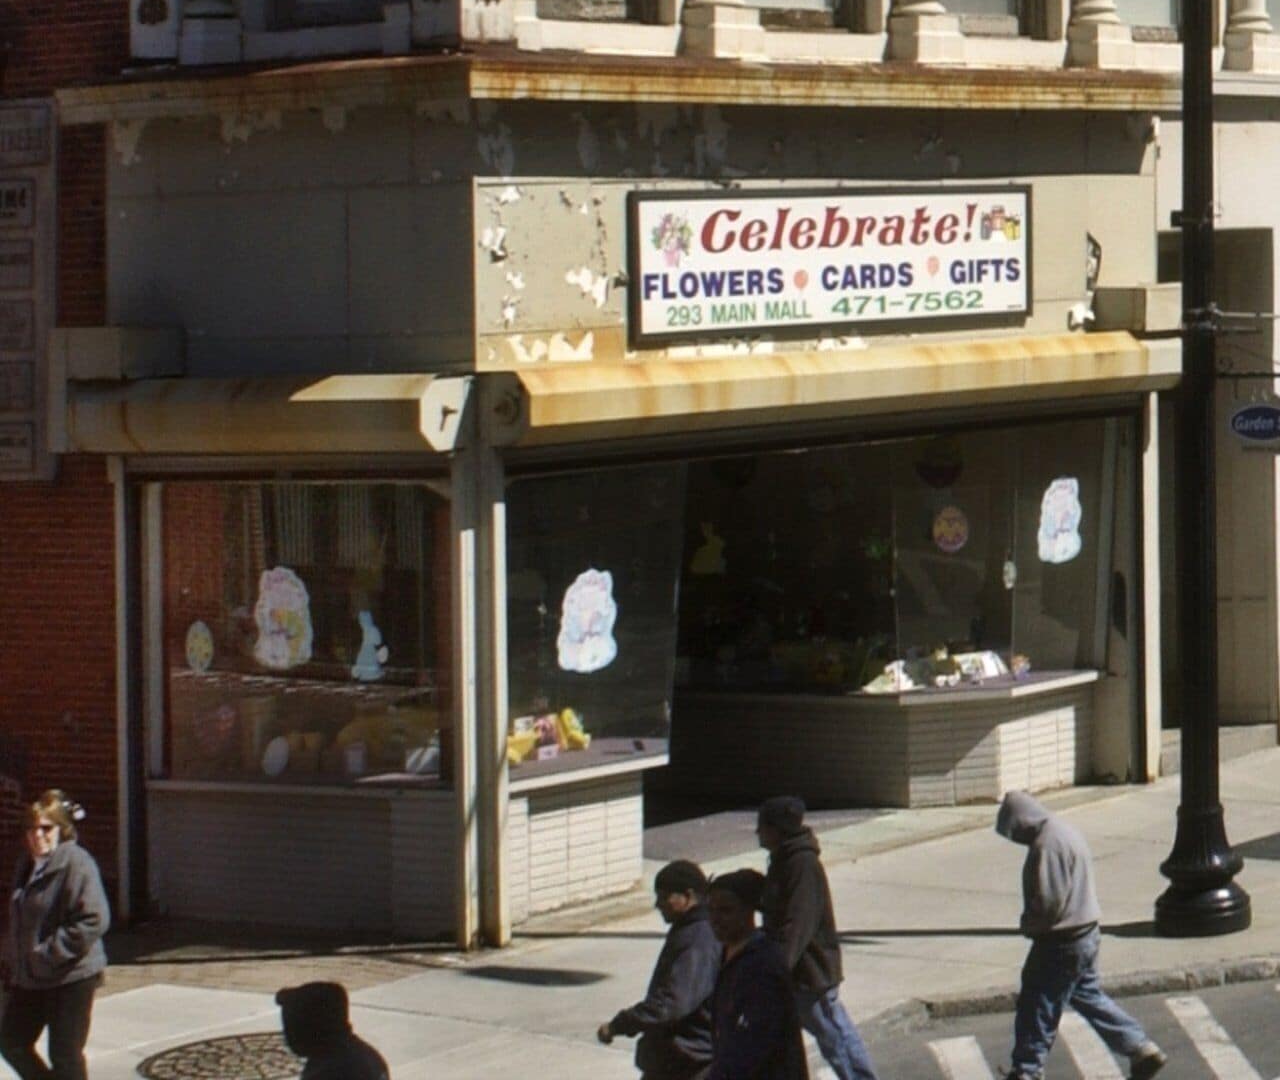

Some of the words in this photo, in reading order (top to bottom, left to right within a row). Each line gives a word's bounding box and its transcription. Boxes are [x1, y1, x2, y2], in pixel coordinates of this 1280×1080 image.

[700, 203, 978, 253] Celebrate!
[643, 267, 785, 300] FLOWERS
[821, 262, 914, 291] CARDS
[949, 257, 1021, 284] GIFTS
[666, 304, 703, 327] 293
[711, 301, 757, 324] MAIN
[764, 299, 813, 321] MALL
[831, 289, 984, 316] 471-7562
[1234, 415, 1275, 432] Garden
